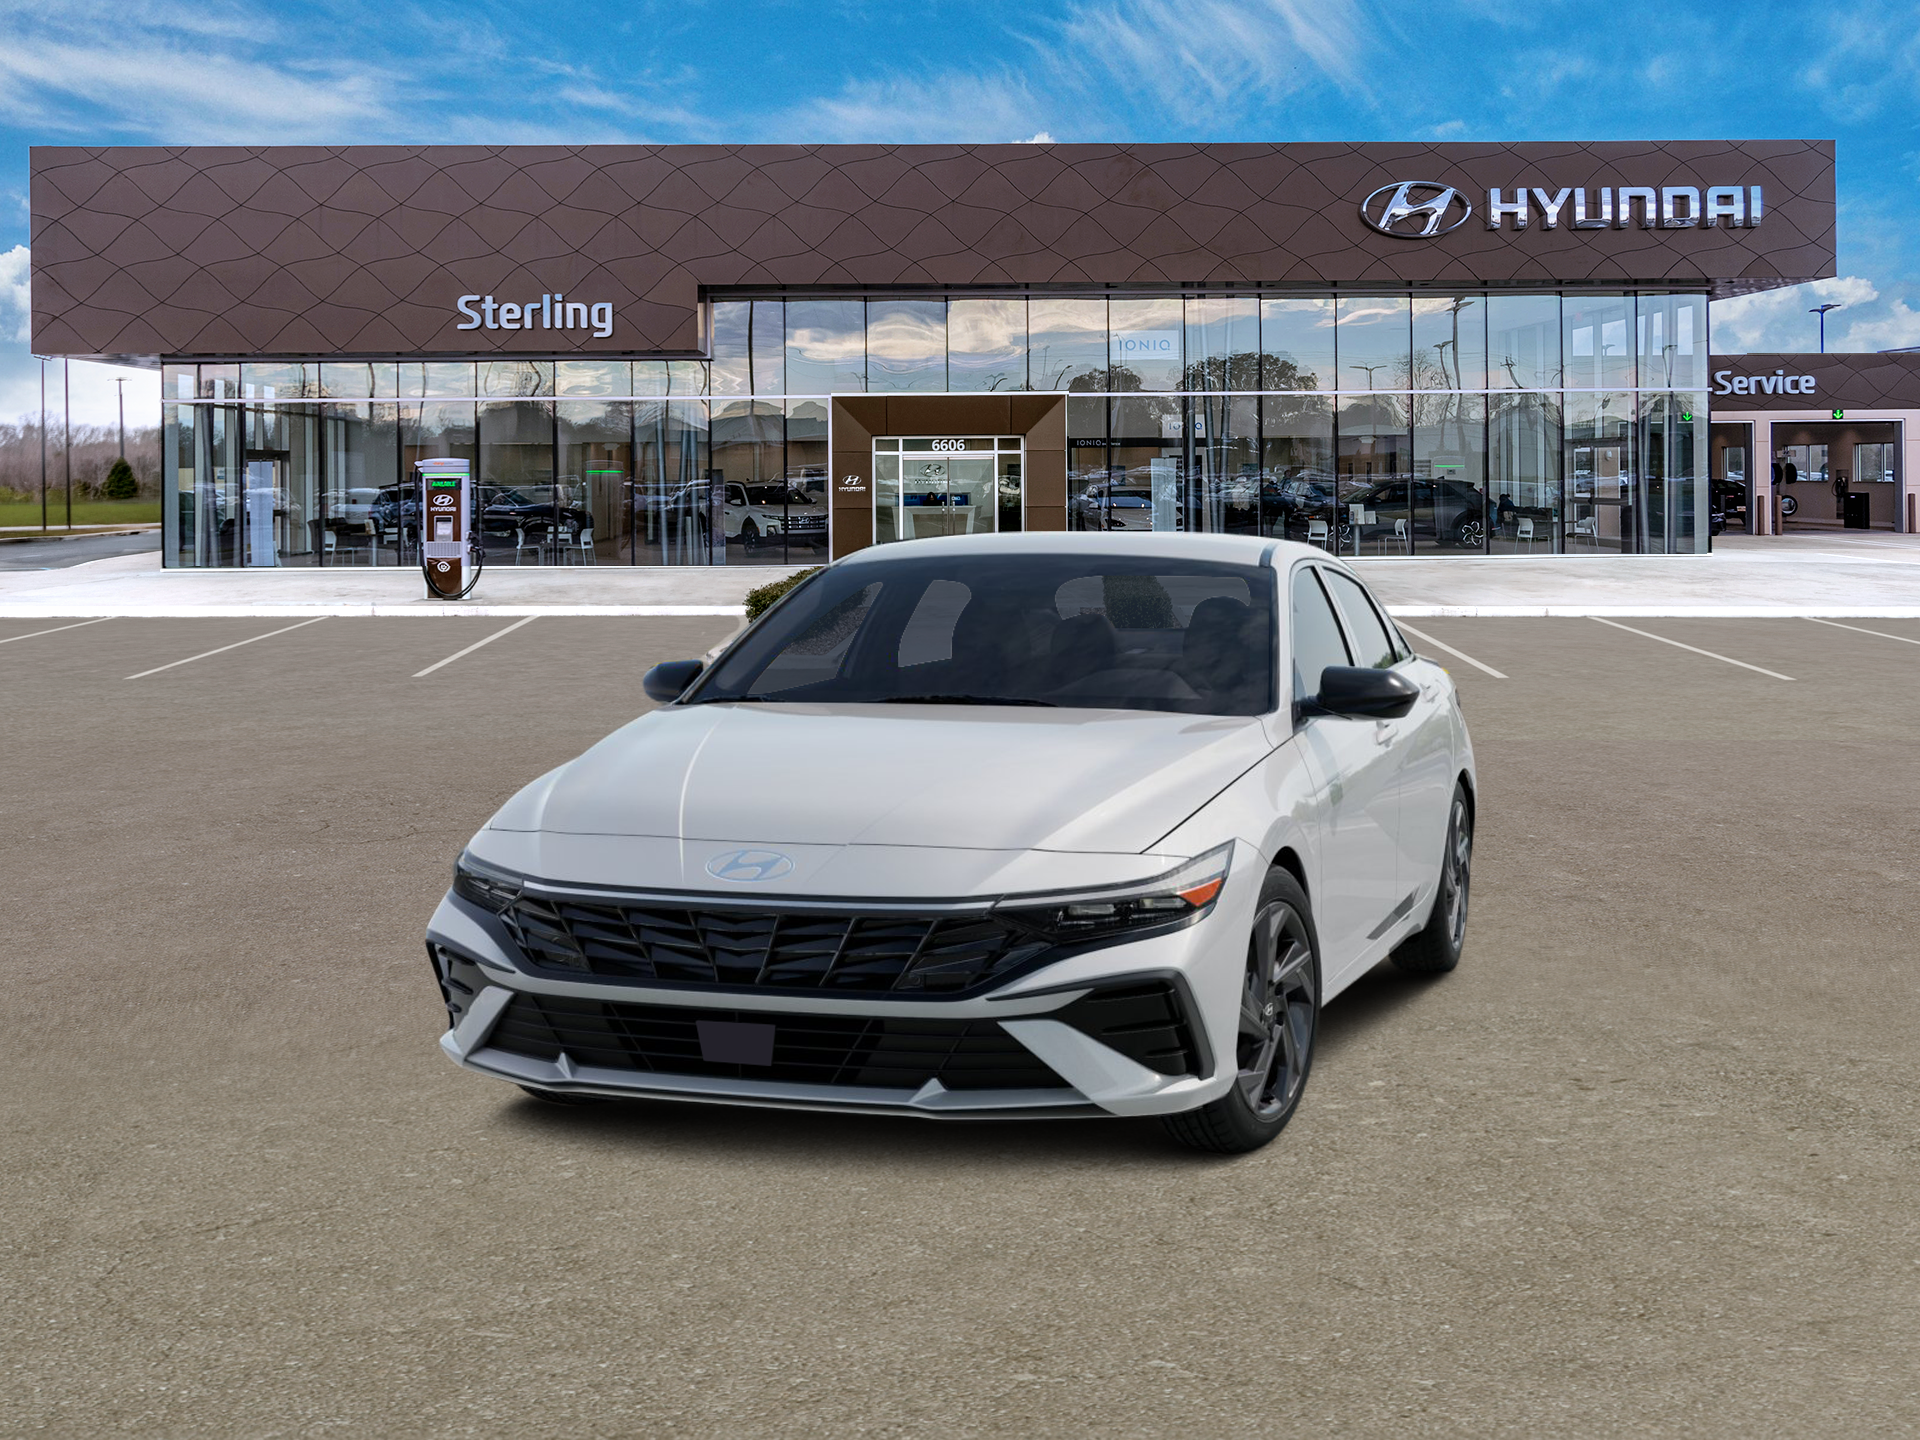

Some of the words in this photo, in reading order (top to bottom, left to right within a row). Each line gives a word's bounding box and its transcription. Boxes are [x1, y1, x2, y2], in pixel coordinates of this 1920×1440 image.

[1487, 186, 1762, 230] HYUNDAI
[457, 293, 613, 338] Sterling
[1118, 339, 1170, 351] IONIQ
[1713, 369, 1816, 395] Service
[1169, 422, 1203, 430] IOQ
[931, 439, 965, 451] 6606
